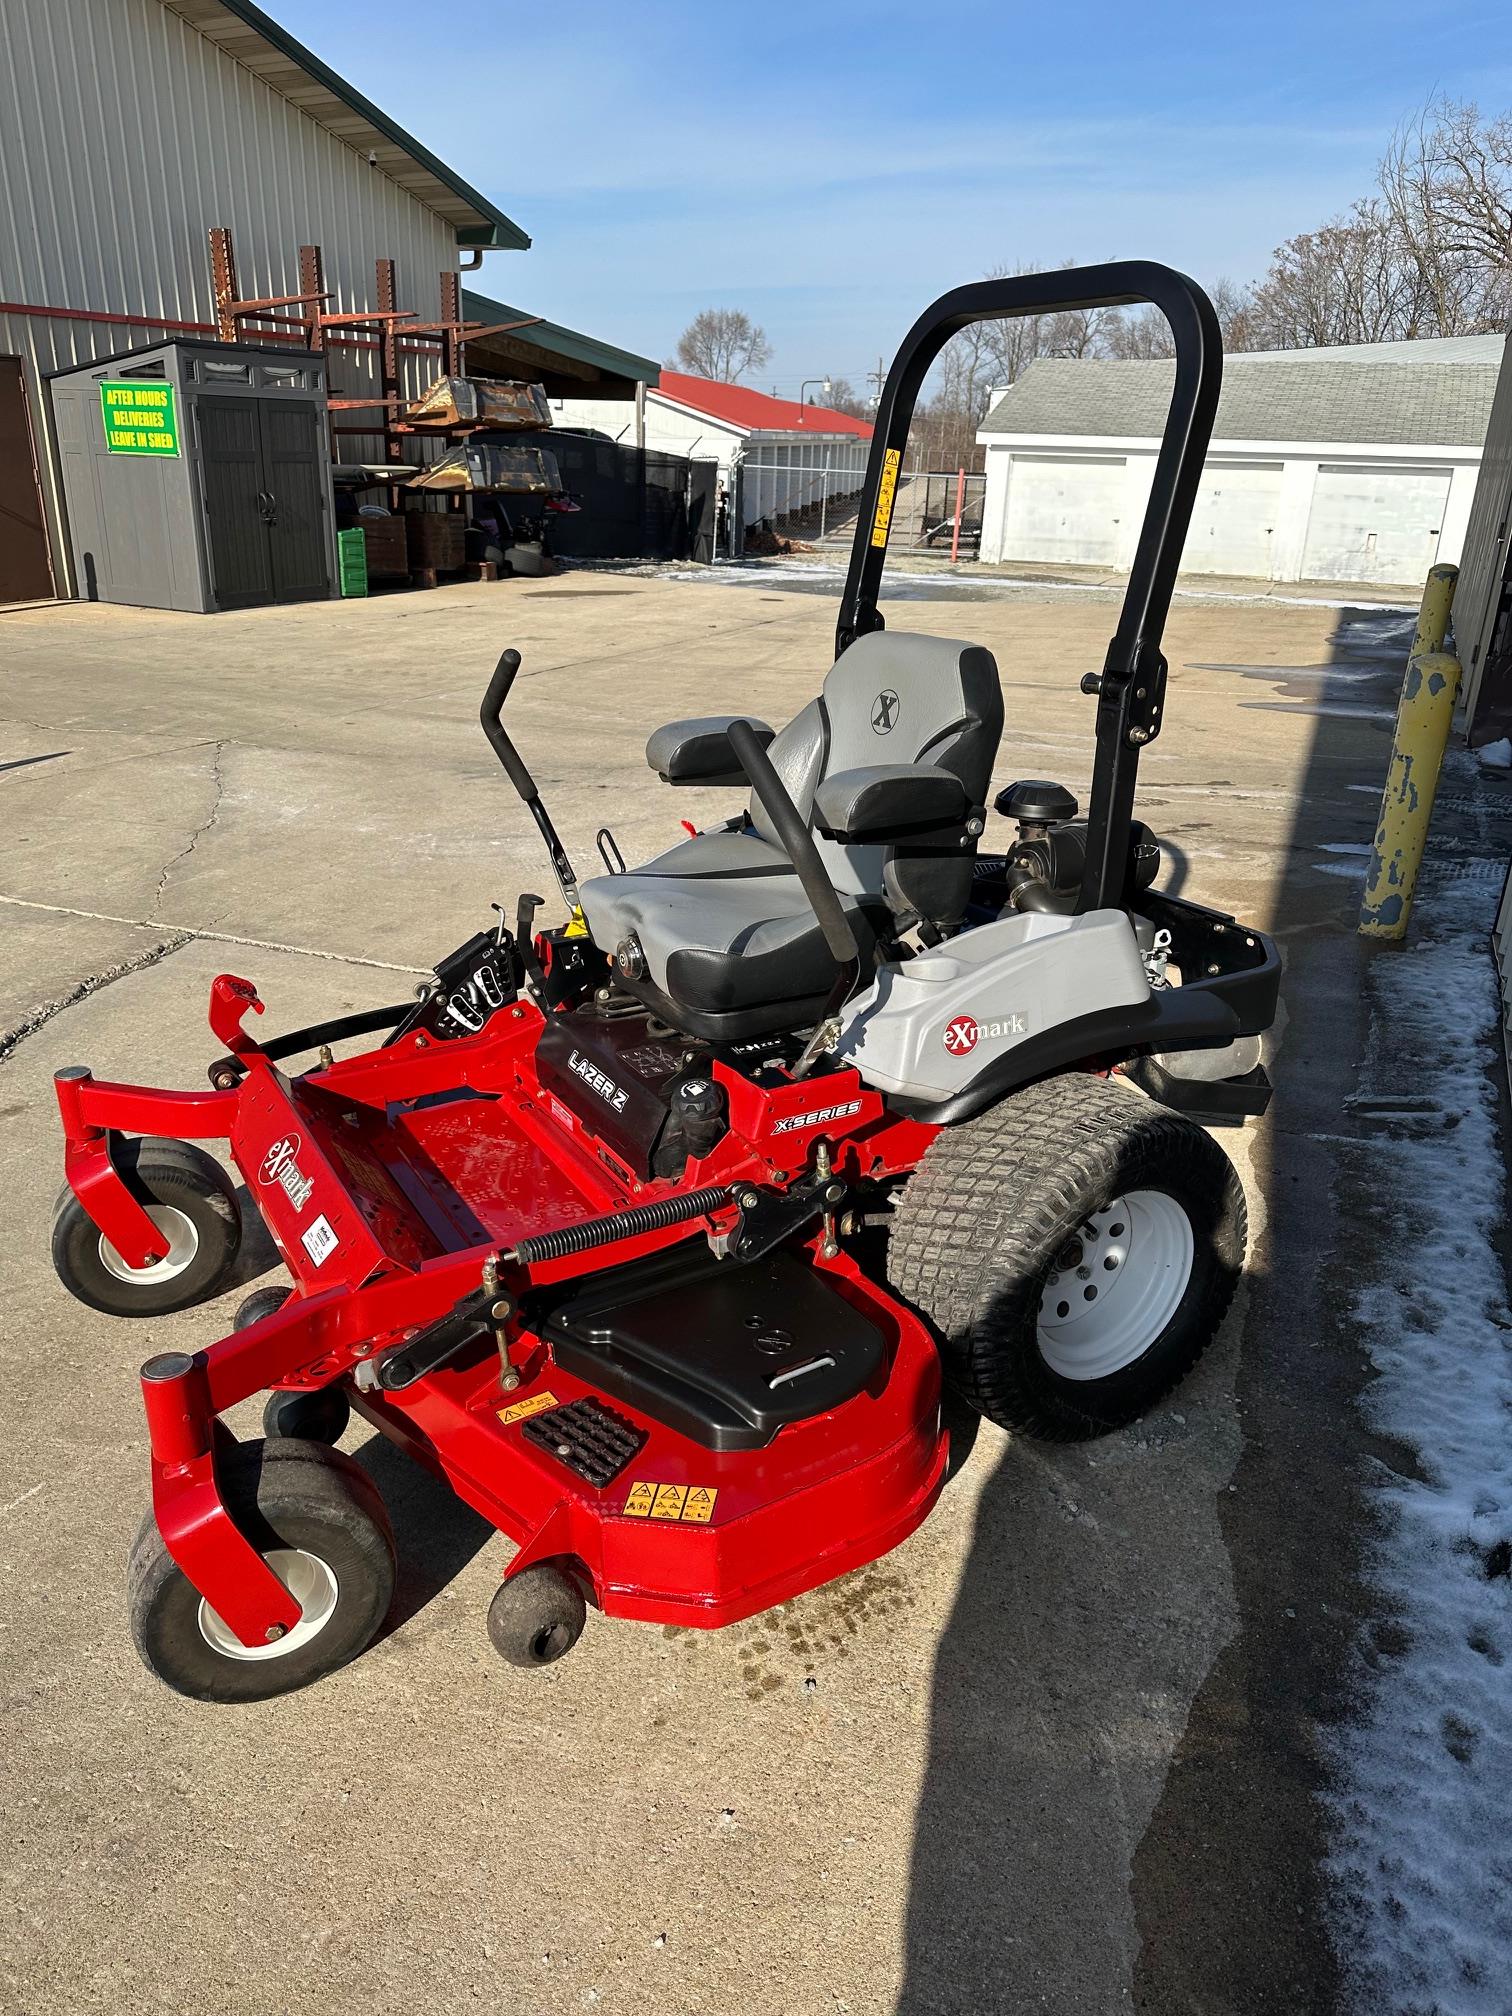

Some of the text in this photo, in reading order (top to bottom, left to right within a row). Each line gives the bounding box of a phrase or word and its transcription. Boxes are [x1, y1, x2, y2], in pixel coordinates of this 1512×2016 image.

[106, 389, 168, 407] AFTER HOURS
[112, 410, 165, 428] DELIVERIES
[109, 430, 174, 449] LEAVE IN SHED
[942, 1014, 1026, 1051] eXmark
[567, 1049, 616, 1103] LAZER
[610, 1087, 630, 1113] Z
[261, 1136, 314, 1210] eXmark
